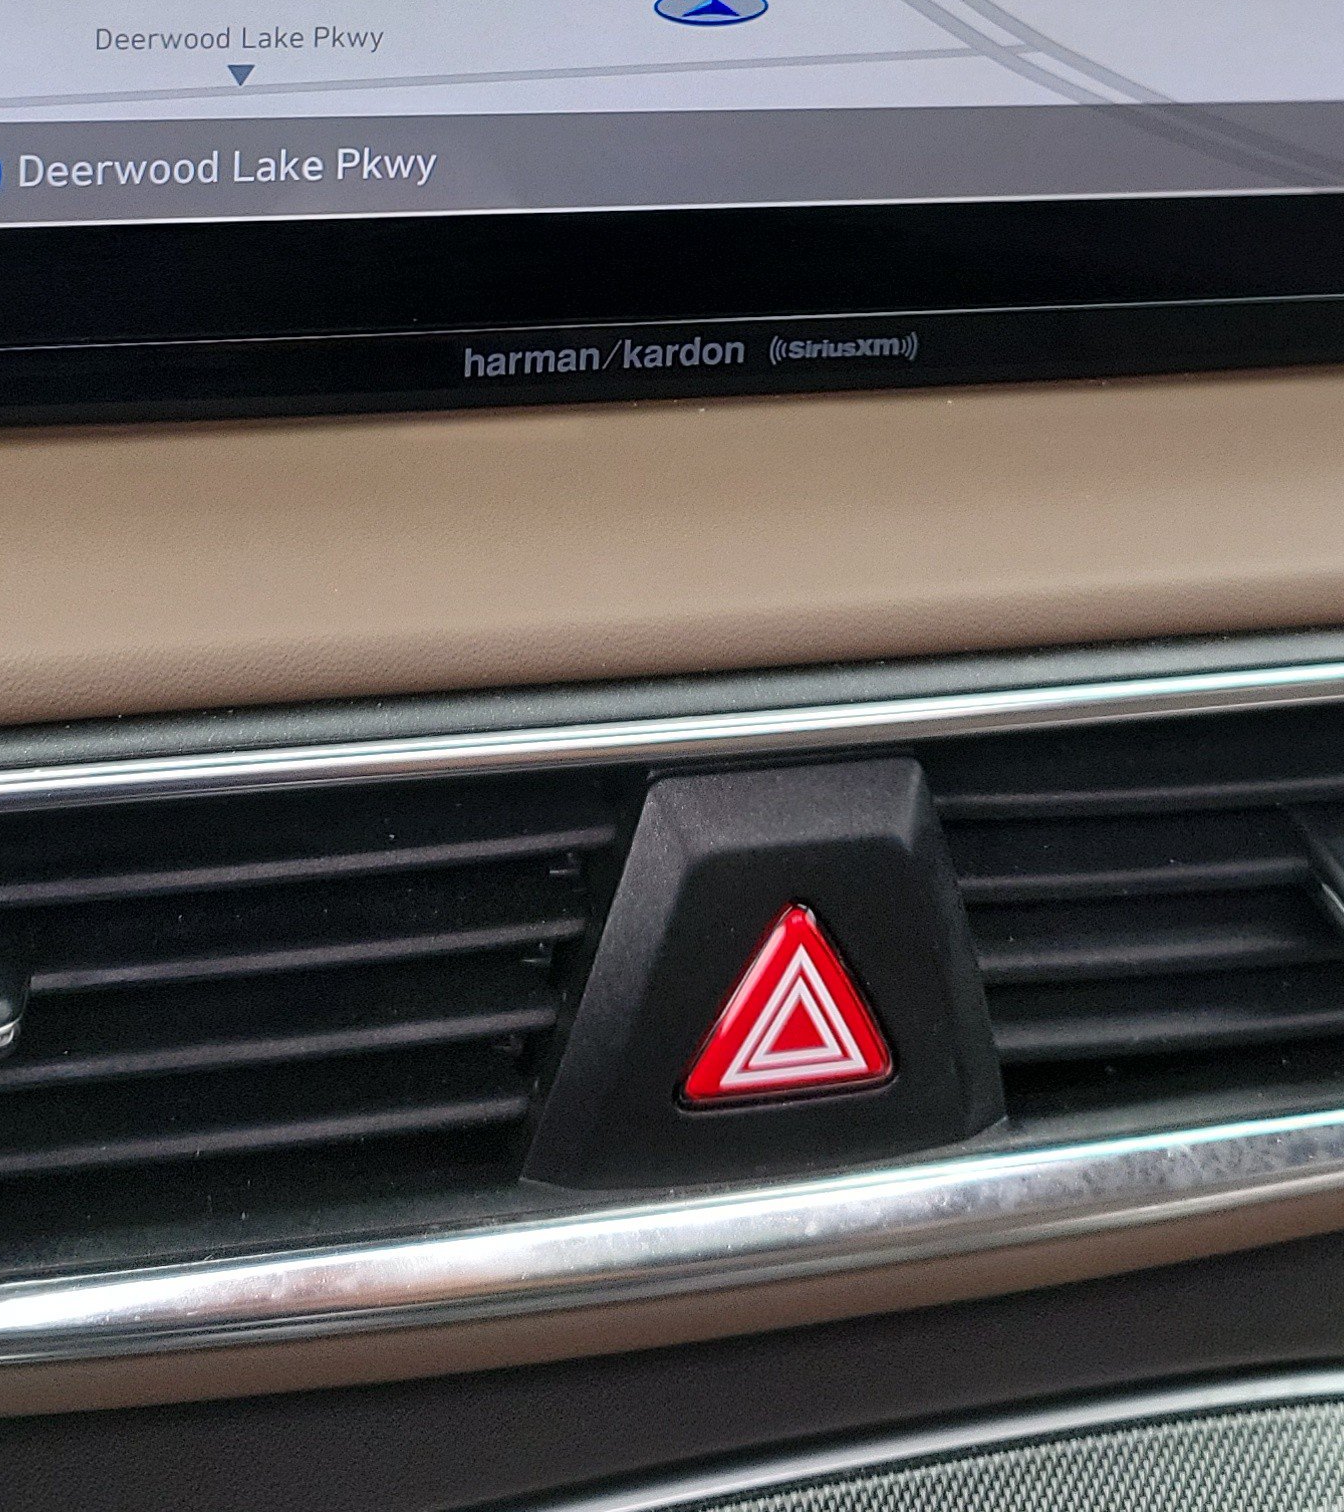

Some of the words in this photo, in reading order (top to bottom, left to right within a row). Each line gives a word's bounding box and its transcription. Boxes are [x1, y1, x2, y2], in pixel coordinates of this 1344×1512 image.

[95, 26, 231, 51] Deerwood
[242, 26, 305, 49] Lake
[313, 25, 385, 53] Pkwy
[19, 149, 219, 188] Deerwood
[233, 148, 324, 183] Lake
[336, 147, 438, 187] Pkwy
[464, 336, 746, 378] harman/kardon
